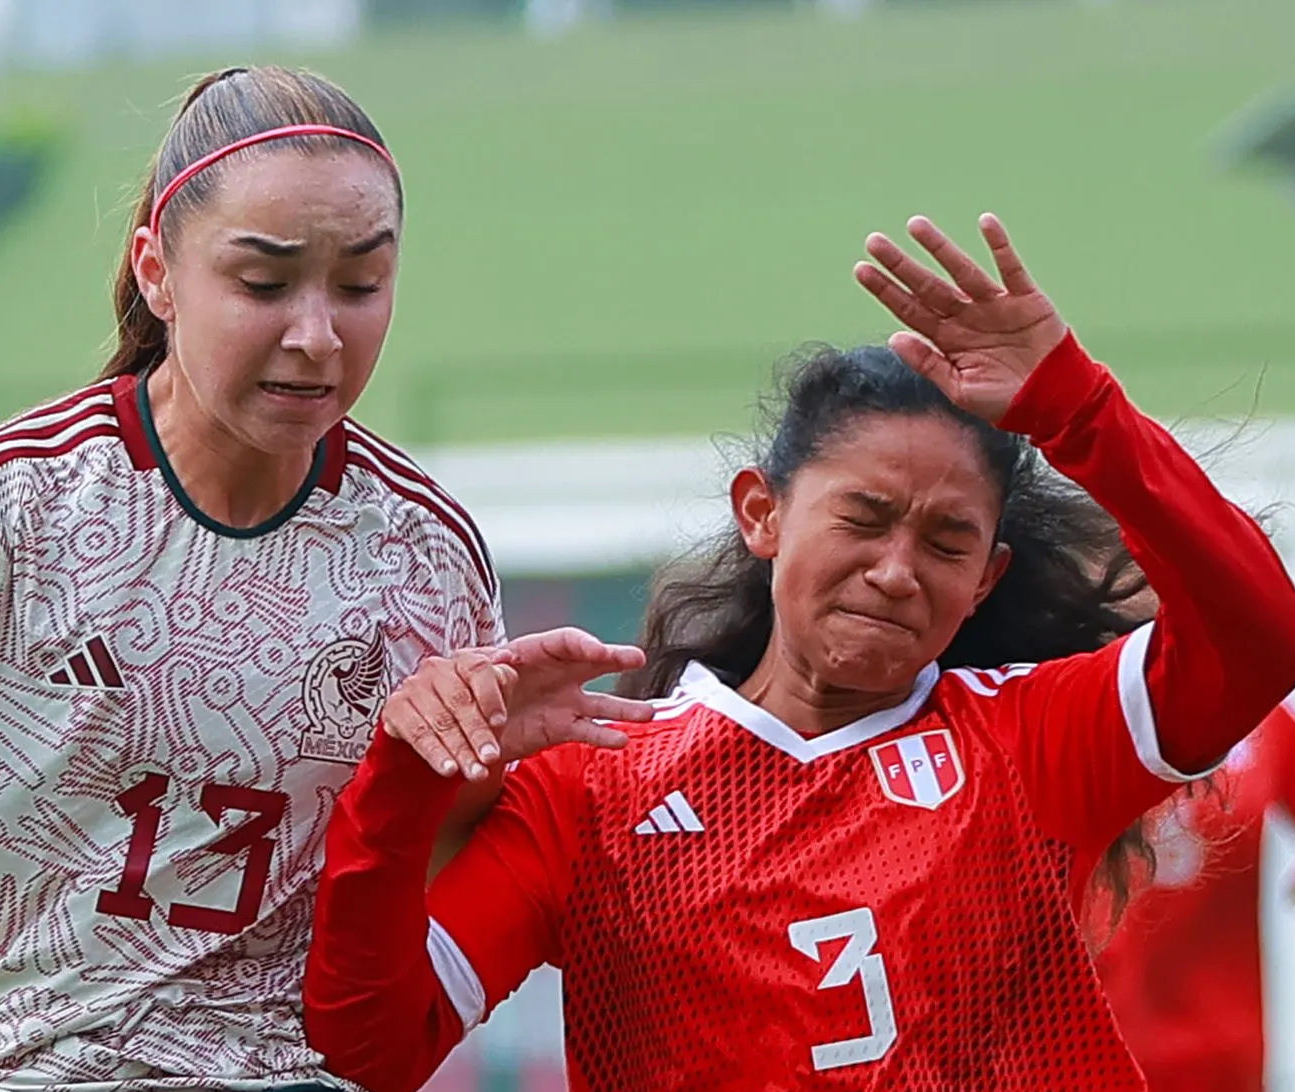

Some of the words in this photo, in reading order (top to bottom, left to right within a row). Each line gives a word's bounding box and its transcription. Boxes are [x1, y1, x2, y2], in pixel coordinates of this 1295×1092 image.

[303, 734, 367, 760] MÉXIC
[95, 771, 292, 936] 13
[787, 906, 899, 1072] 3
